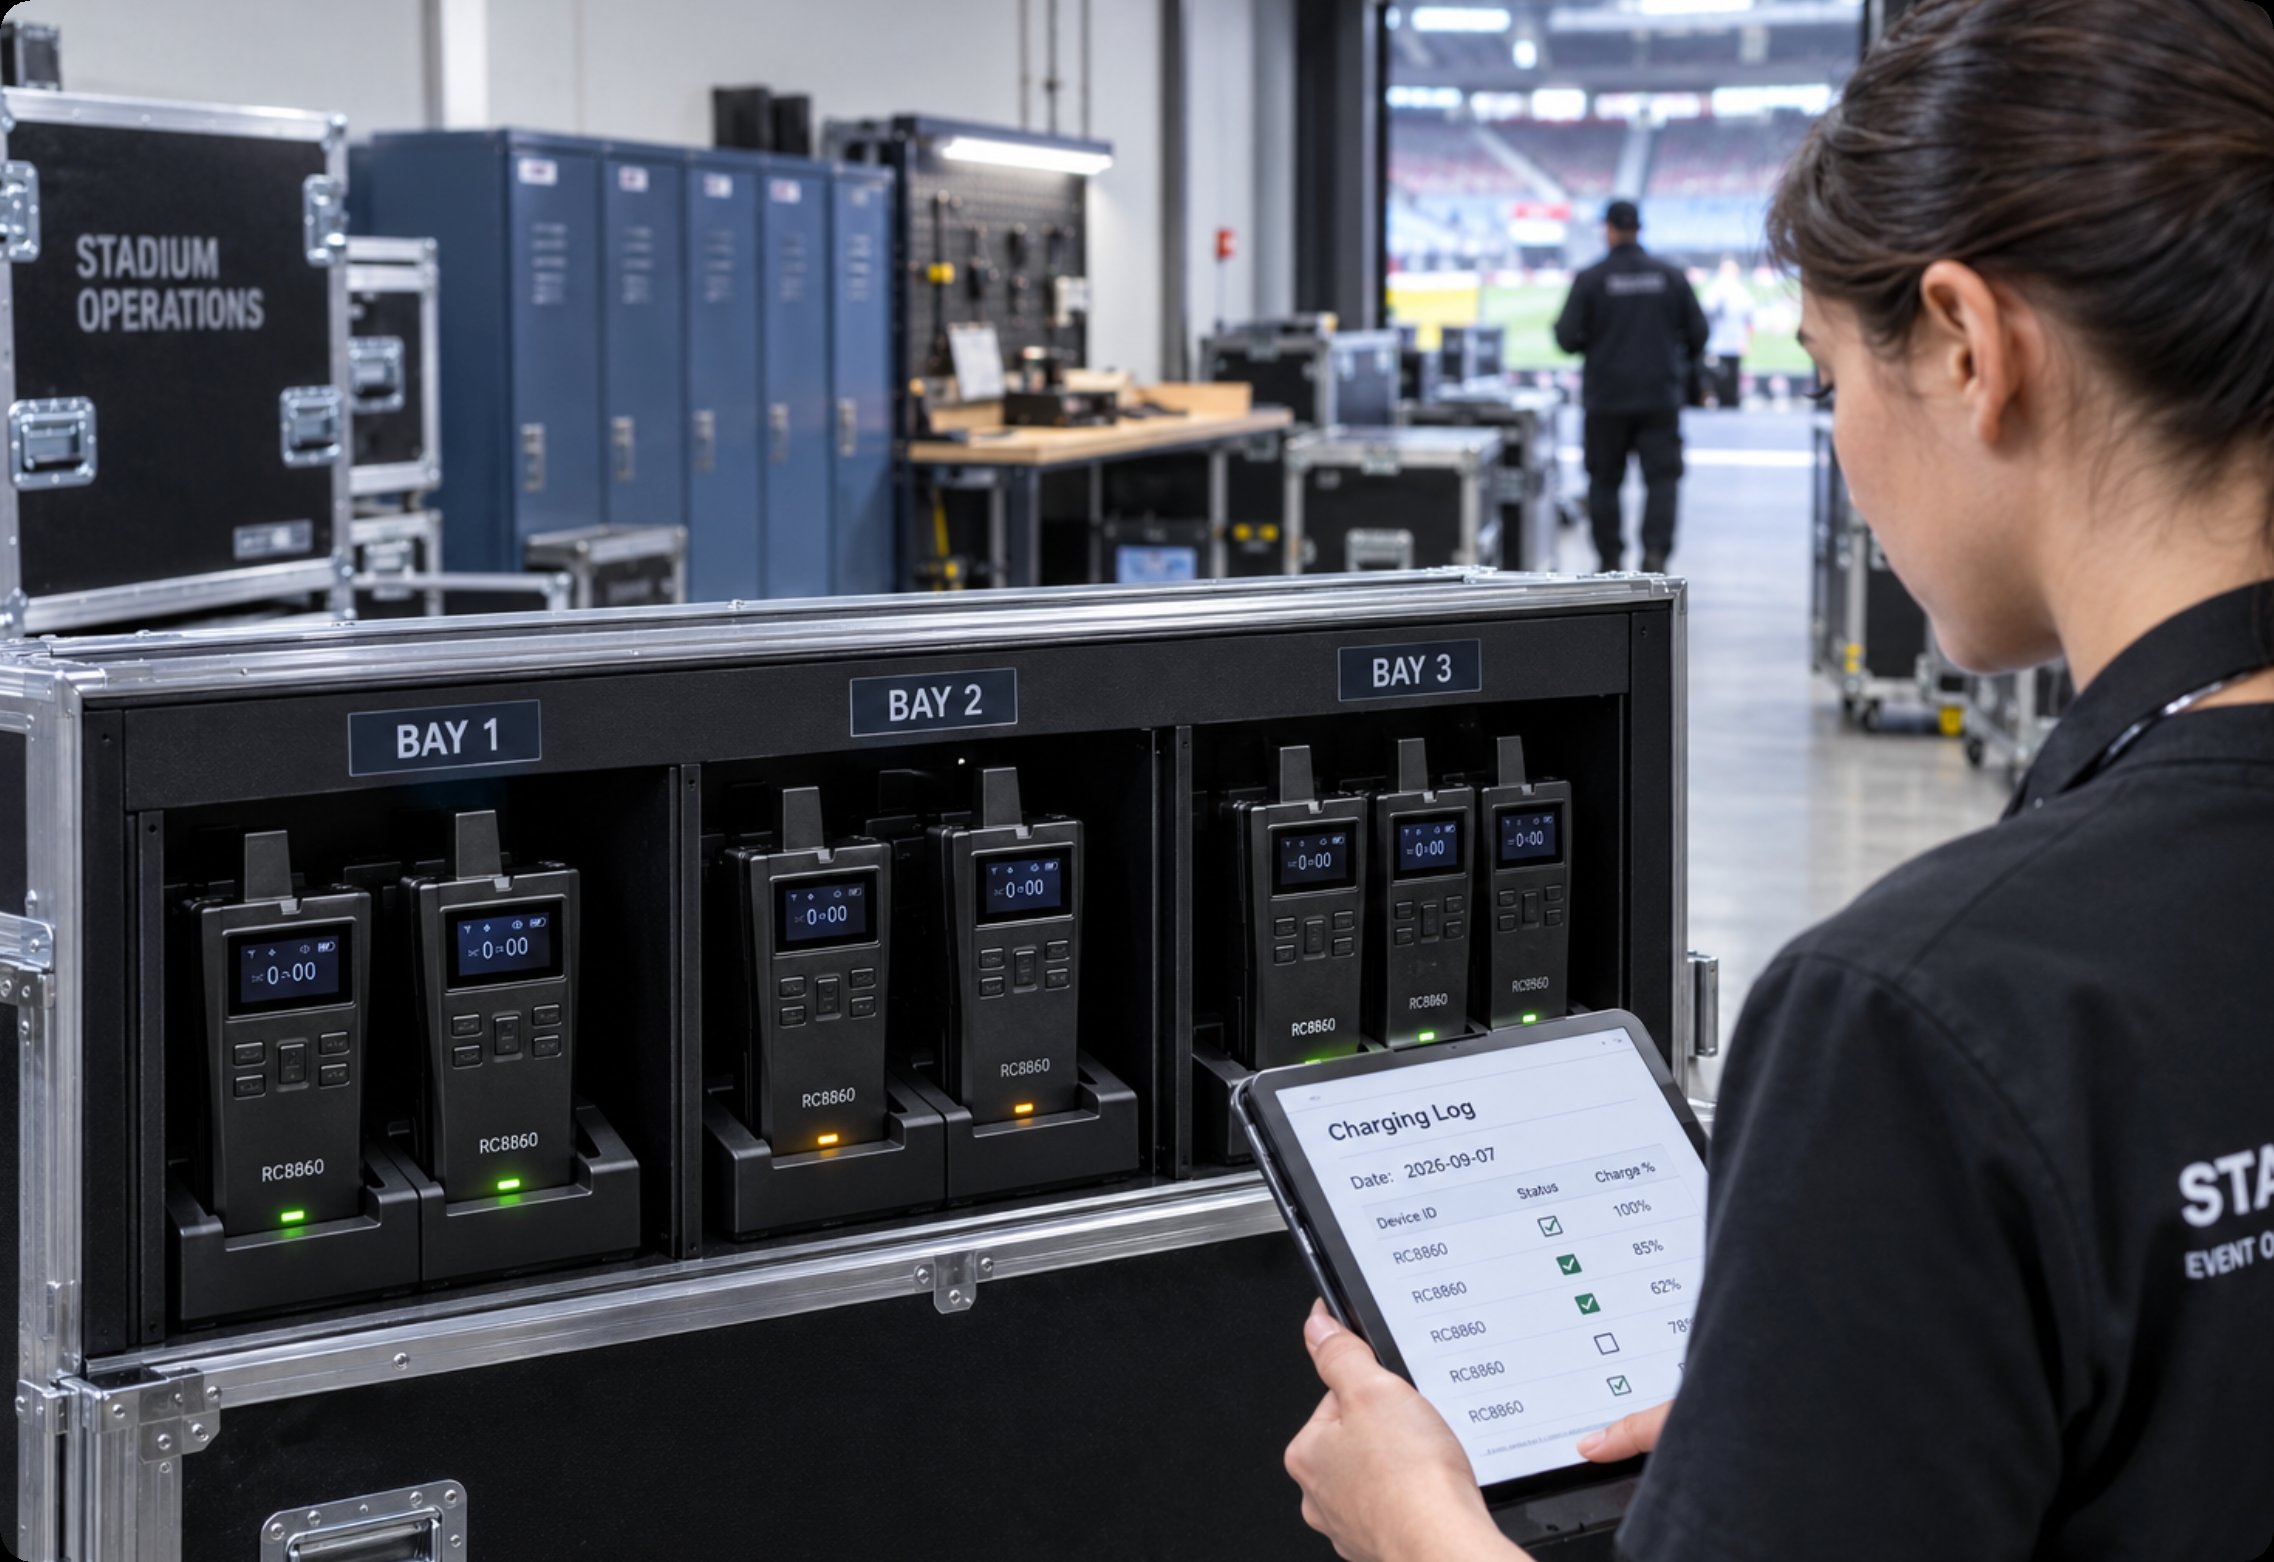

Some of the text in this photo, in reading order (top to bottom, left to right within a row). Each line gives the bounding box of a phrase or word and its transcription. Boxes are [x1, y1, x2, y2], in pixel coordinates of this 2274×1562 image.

[76, 233, 219, 279] STADIUM
[77, 287, 265, 333] OPERATIONS
[1372, 653, 1452, 688] BAY 3
[888, 683, 983, 721] BAY 2
[397, 717, 498, 759] BAY 1
[1291, 1017, 1336, 1037] RC8860
[1000, 1057, 1050, 1078] RC8860
[801, 1087, 856, 1108] RC8860
[1327, 1101, 1476, 1141] Charging Log
[479, 1131, 539, 1154] RC8860
[261, 1158, 324, 1182] RC8860
[1350, 1146, 1495, 1190] Date: 2026-09-07
[1376, 1211, 1421, 1230] Device
[1422, 1206, 1437, 1220] ID
[1595, 1166, 1641, 1183] Charge
[1392, 1199, 1652, 1264] RC8860 100%
[1411, 1239, 1664, 1304] RC8860 85%
[2184, 1236, 2256, 1279] EVENT
[1430, 1278, 1682, 1343] RC8860 62%
[1449, 1360, 1505, 1383] RC8860
[1468, 1400, 1524, 1423] RC8860
